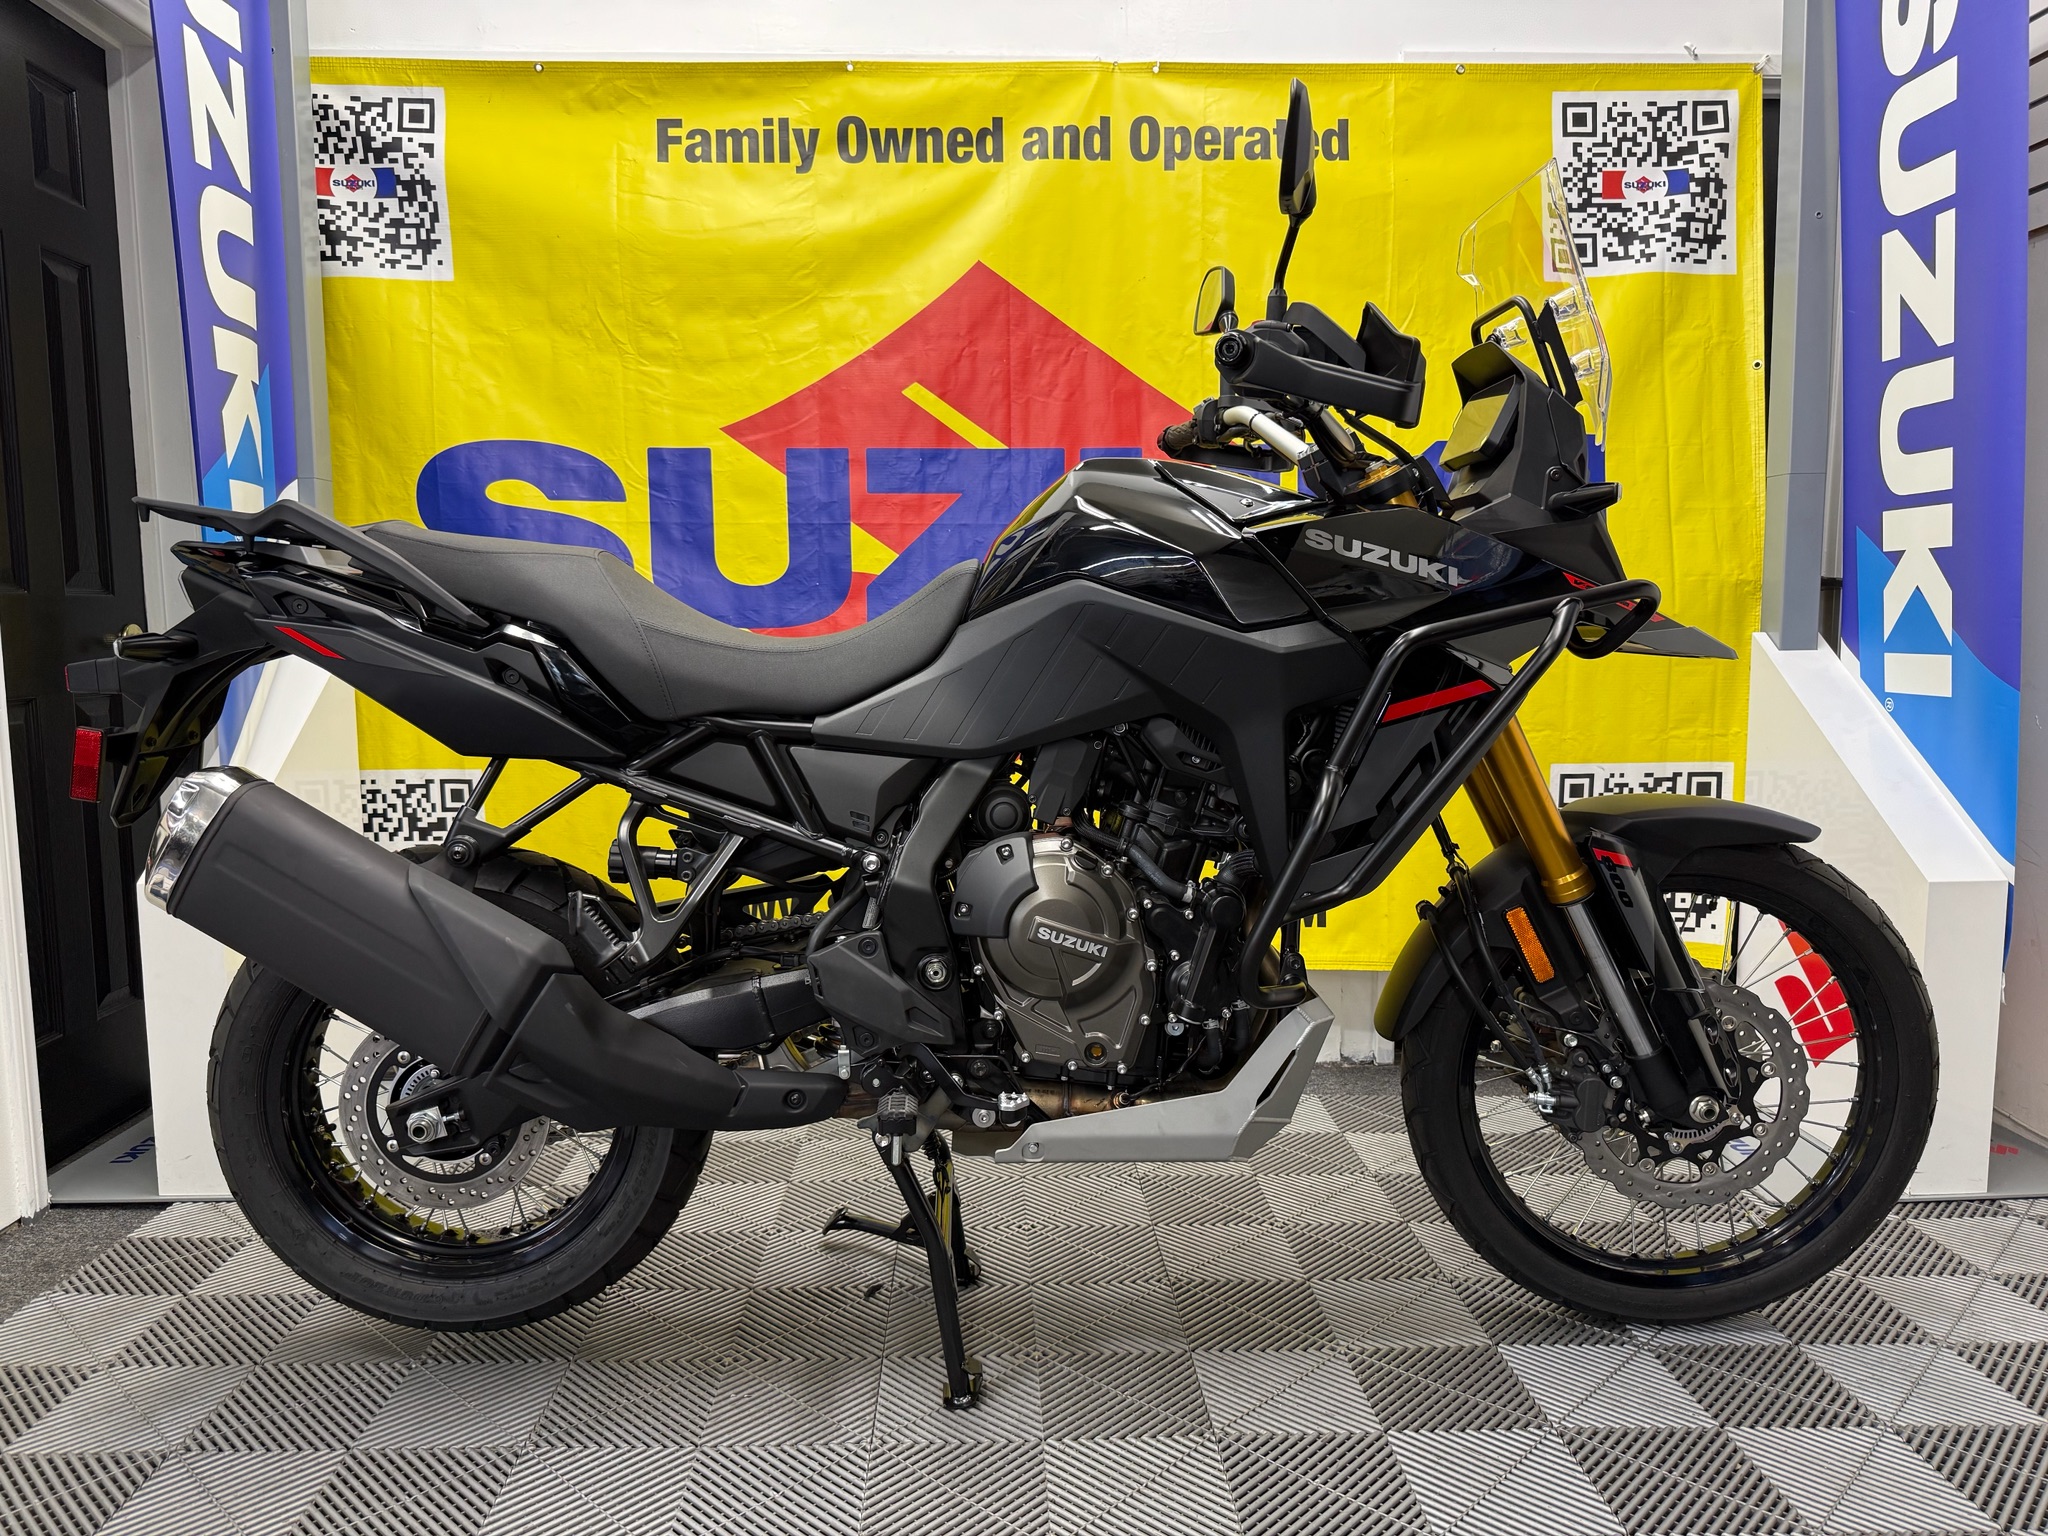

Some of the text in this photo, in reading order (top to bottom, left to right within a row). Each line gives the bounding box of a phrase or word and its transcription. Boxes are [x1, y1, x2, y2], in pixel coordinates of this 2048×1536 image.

[656, 115, 1350, 175] Family Owned and Operad
[332, 179, 375, 188] SUZUKI
[1624, 180, 1666, 189] SUZUKI
[1304, 528, 1459, 587] SUZUKI
[1600, 855, 1634, 909] 800
[1037, 926, 1109, 958] SUZUKI
